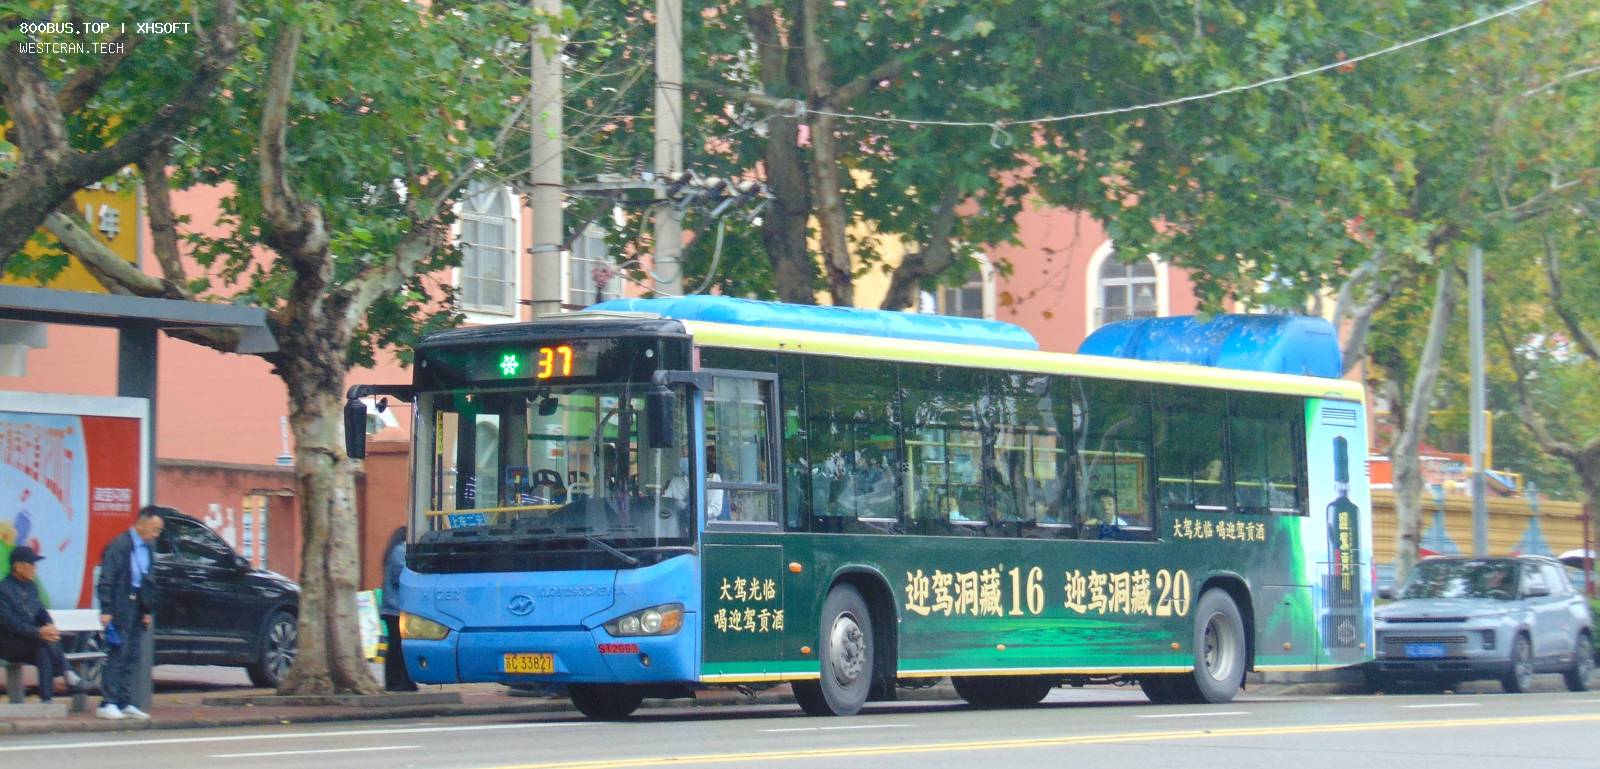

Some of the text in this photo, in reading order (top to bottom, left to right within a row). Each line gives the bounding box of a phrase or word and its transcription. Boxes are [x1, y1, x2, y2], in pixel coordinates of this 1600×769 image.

[537, 345, 573, 379] 37
[1173, 517, 1265, 541] 大驾光临 喝迎驾贡酒
[720, 576, 776, 602] 大驾光临
[713, 606, 784, 633] 喝迎驾贡酒
